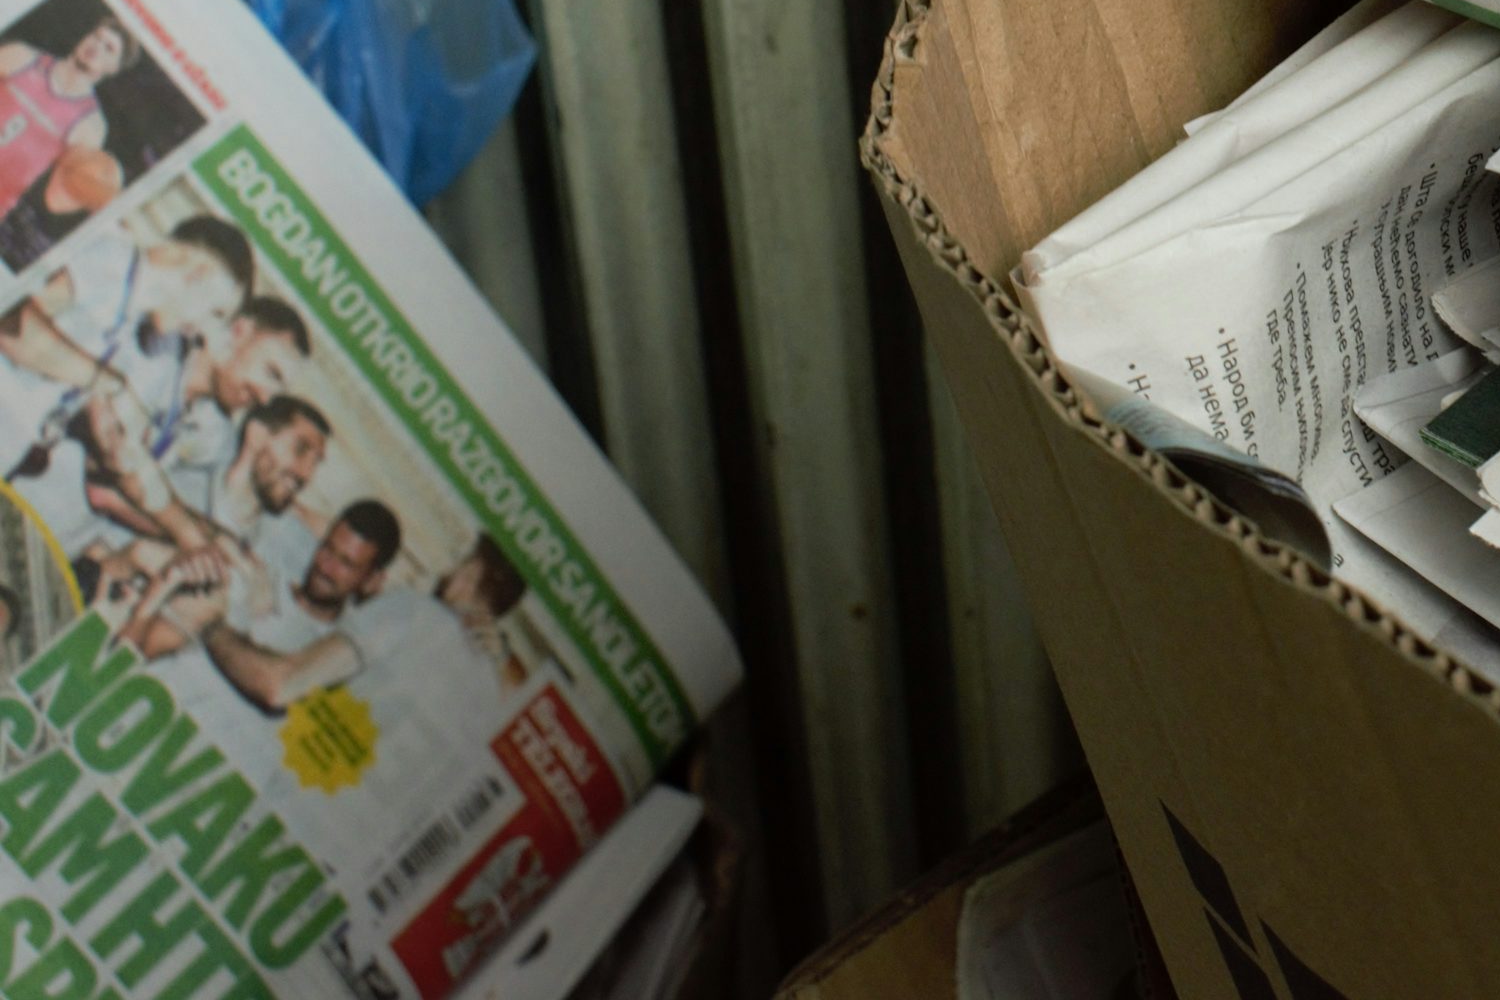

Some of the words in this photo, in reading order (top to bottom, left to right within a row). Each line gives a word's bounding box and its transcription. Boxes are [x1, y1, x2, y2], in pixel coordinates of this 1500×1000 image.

[1415, 171, 1439, 207] Шта
[1320, 239, 1335, 271] јер
[1341, 227, 1358, 303] Њихова
[1389, 218, 1406, 290] нећемо
[1401, 231, 1426, 320] догодило
[1264, 308, 1281, 343] где
[1294, 272, 1317, 373] Помажем
[1324, 273, 1343, 323] нико
[214, 143, 353, 298] BOGDAN
[323, 278, 440, 409] OTKRIO
[417, 392, 573, 578] RAZGOVOR
[1280, 288, 1304, 395] Преносим
[1334, 325, 1349, 353] не
[1348, 306, 1366, 387] предста
[1418, 323, 1434, 349] на
[1184, 353, 1209, 382] да
[1197, 383, 1231, 442] нема
[1216, 337, 1249, 412] Народ
[1239, 411, 1256, 439] би
[1271, 346, 1290, 412] треба.
[1340, 419, 1374, 488] спусти
[15, 610, 346, 970] NOVAKU
